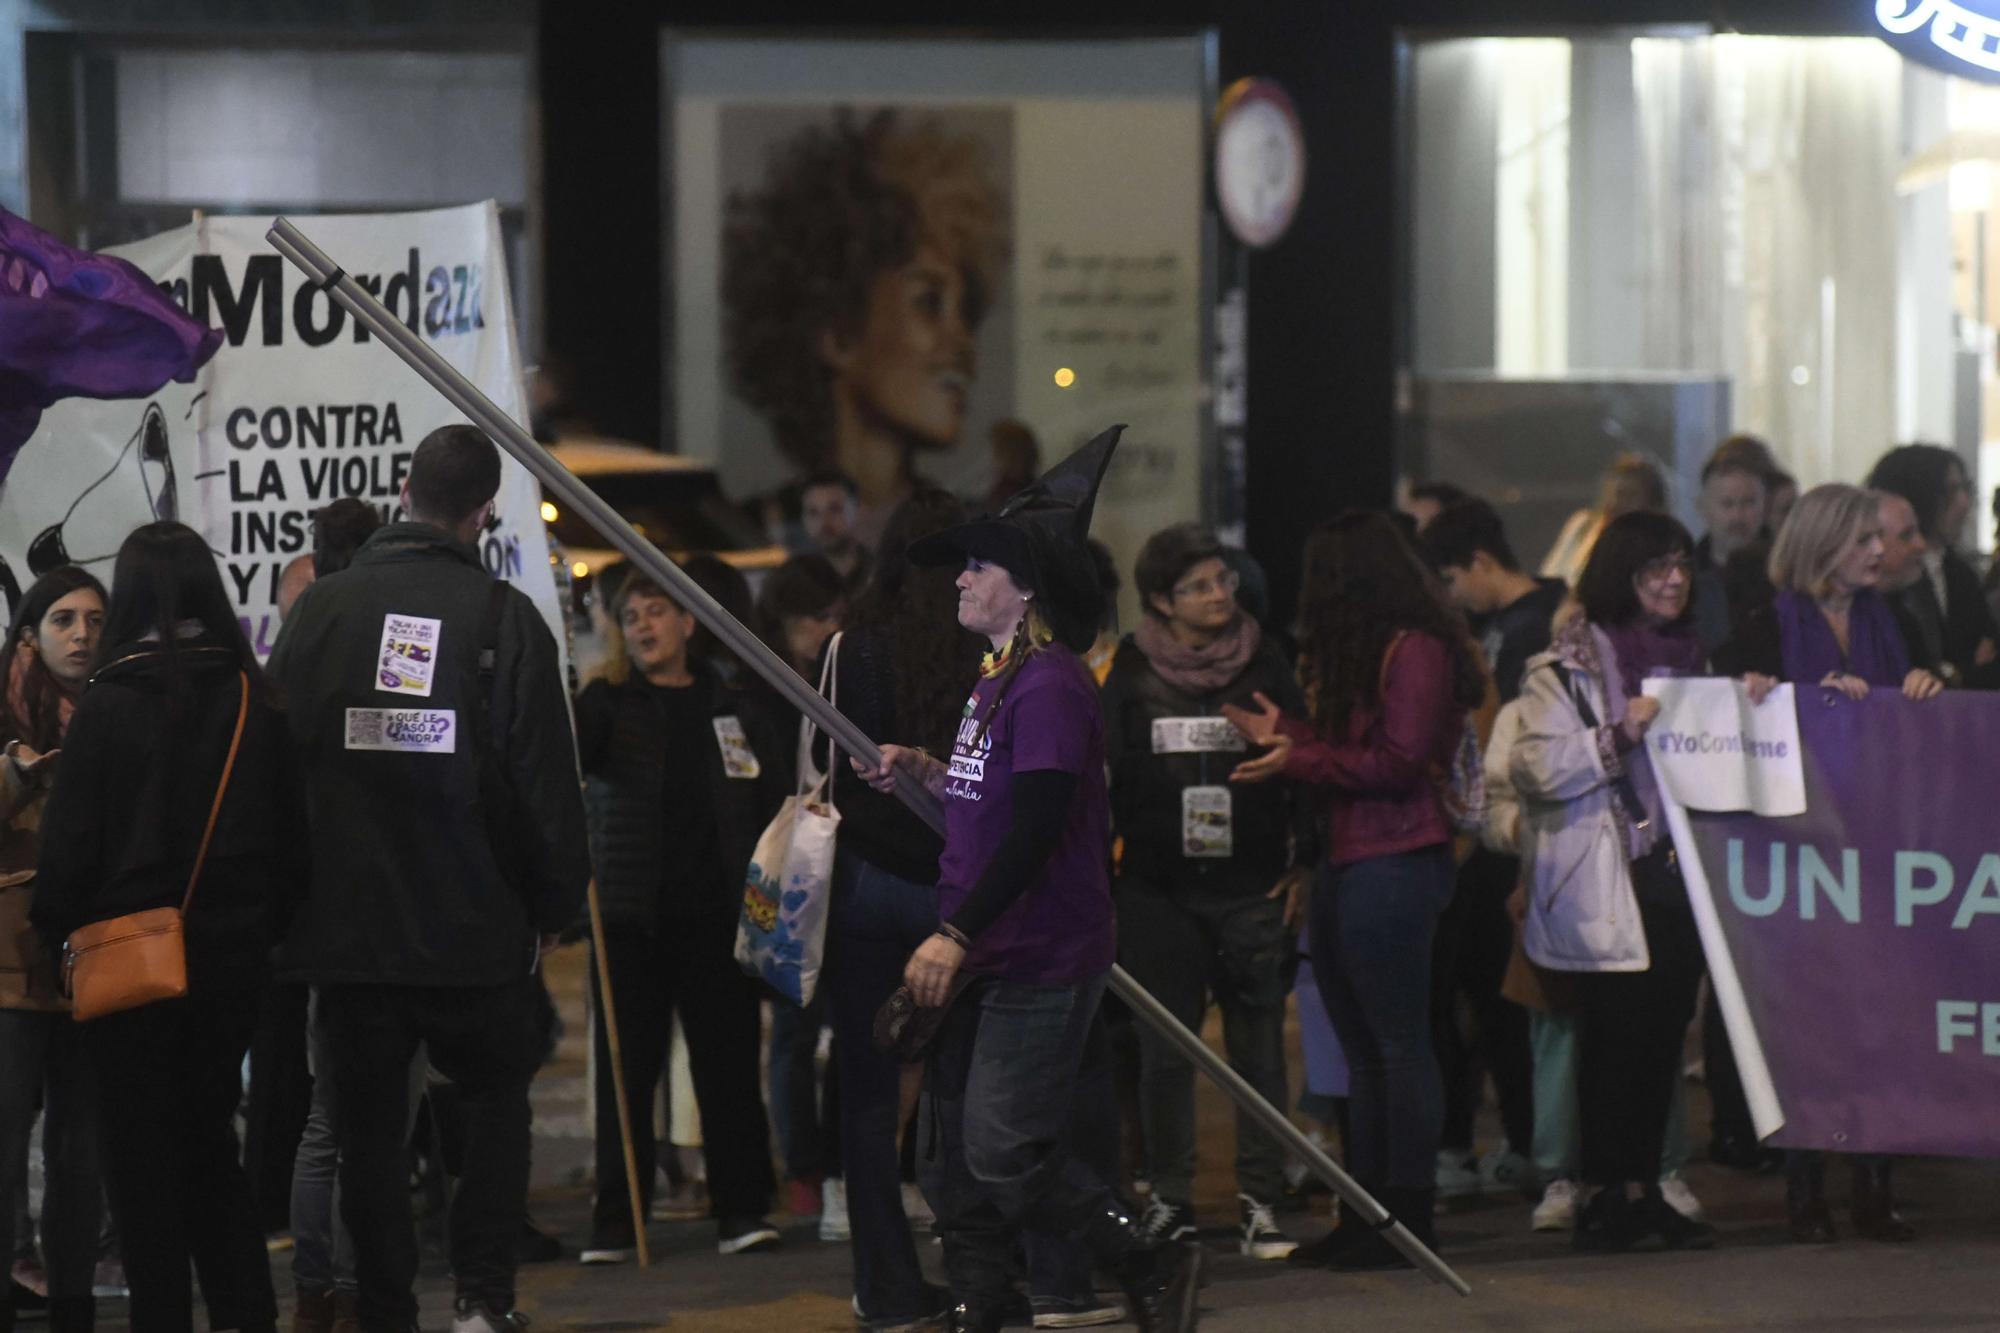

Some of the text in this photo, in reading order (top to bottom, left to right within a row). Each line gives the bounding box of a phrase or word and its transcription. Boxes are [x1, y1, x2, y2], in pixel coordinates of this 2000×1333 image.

[225, 402, 403, 450] CONTRA
[229, 452, 412, 502] LA VIOLE
[228, 563, 260, 605] Y
[1727, 838, 1861, 924] UN
